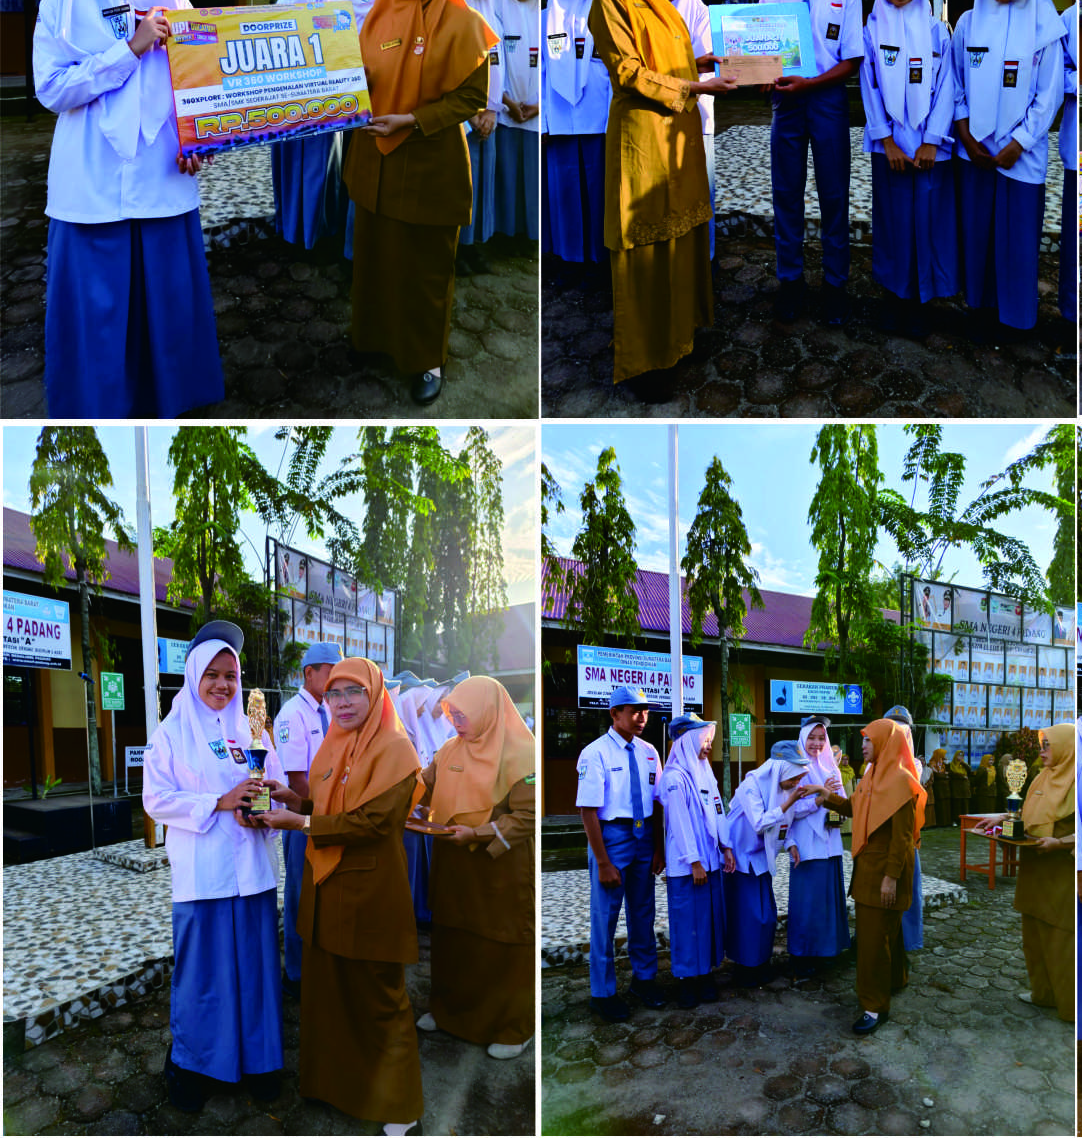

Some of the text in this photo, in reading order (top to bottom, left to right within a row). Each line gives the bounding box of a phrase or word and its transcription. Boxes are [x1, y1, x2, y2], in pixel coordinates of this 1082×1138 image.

[243, 21, 293, 33] DOORPRIZE
[219, 33, 325, 76] JUARA 1
[226, 78, 244, 88] VR
[265, 68, 322, 82] WORKSHOP
[225, 88, 263, 100] WORKSHOP
[194, 93, 359, 140] RP.500.000
[7, 616, 61, 639] 4 PADANG
[585, 666, 606, 681] SMA
[610, 668, 647, 685] NEGERI
[649, 671, 655, 685] 4
